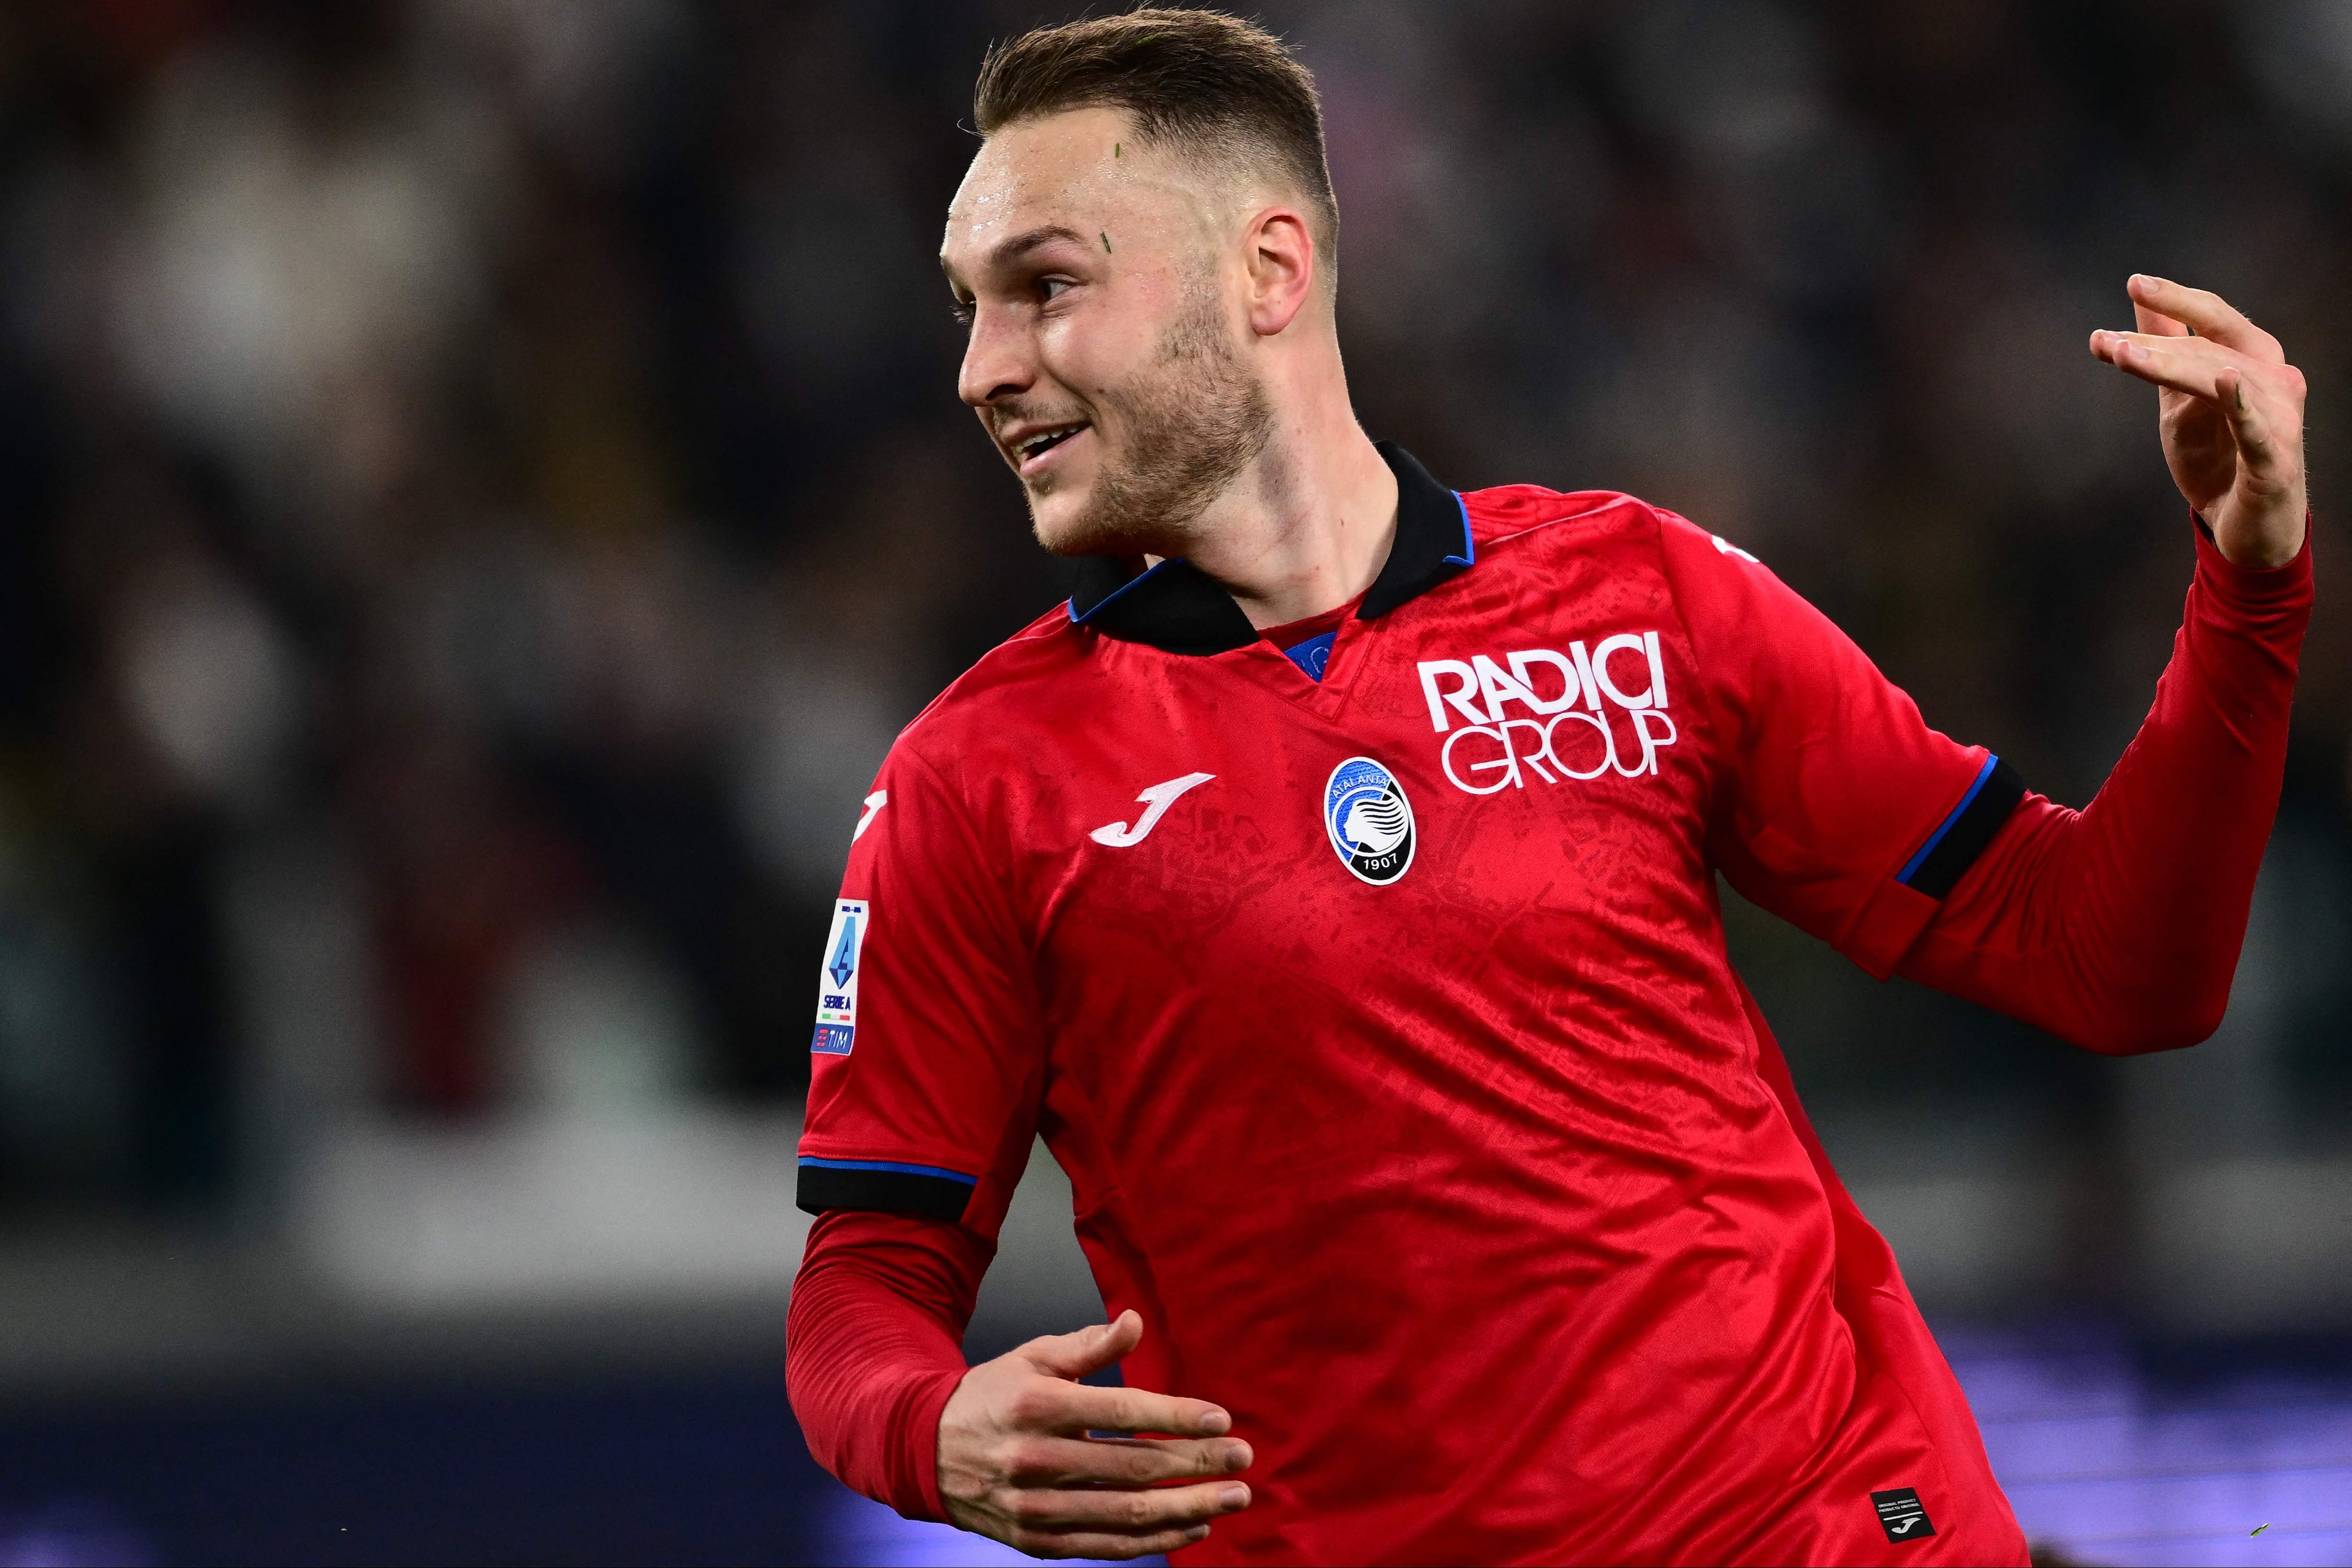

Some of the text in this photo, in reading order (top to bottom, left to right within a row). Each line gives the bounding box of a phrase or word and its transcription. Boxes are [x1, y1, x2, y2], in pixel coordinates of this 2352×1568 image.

[1417, 631, 1668, 732] RADICI
[1441, 710, 1677, 795] GROUP
[1332, 774, 1387, 798] ATALANTA
[1363, 852, 1398, 870] 1907
[823, 995, 851, 1010] SERIE A
[828, 1030, 848, 1049] TIM
